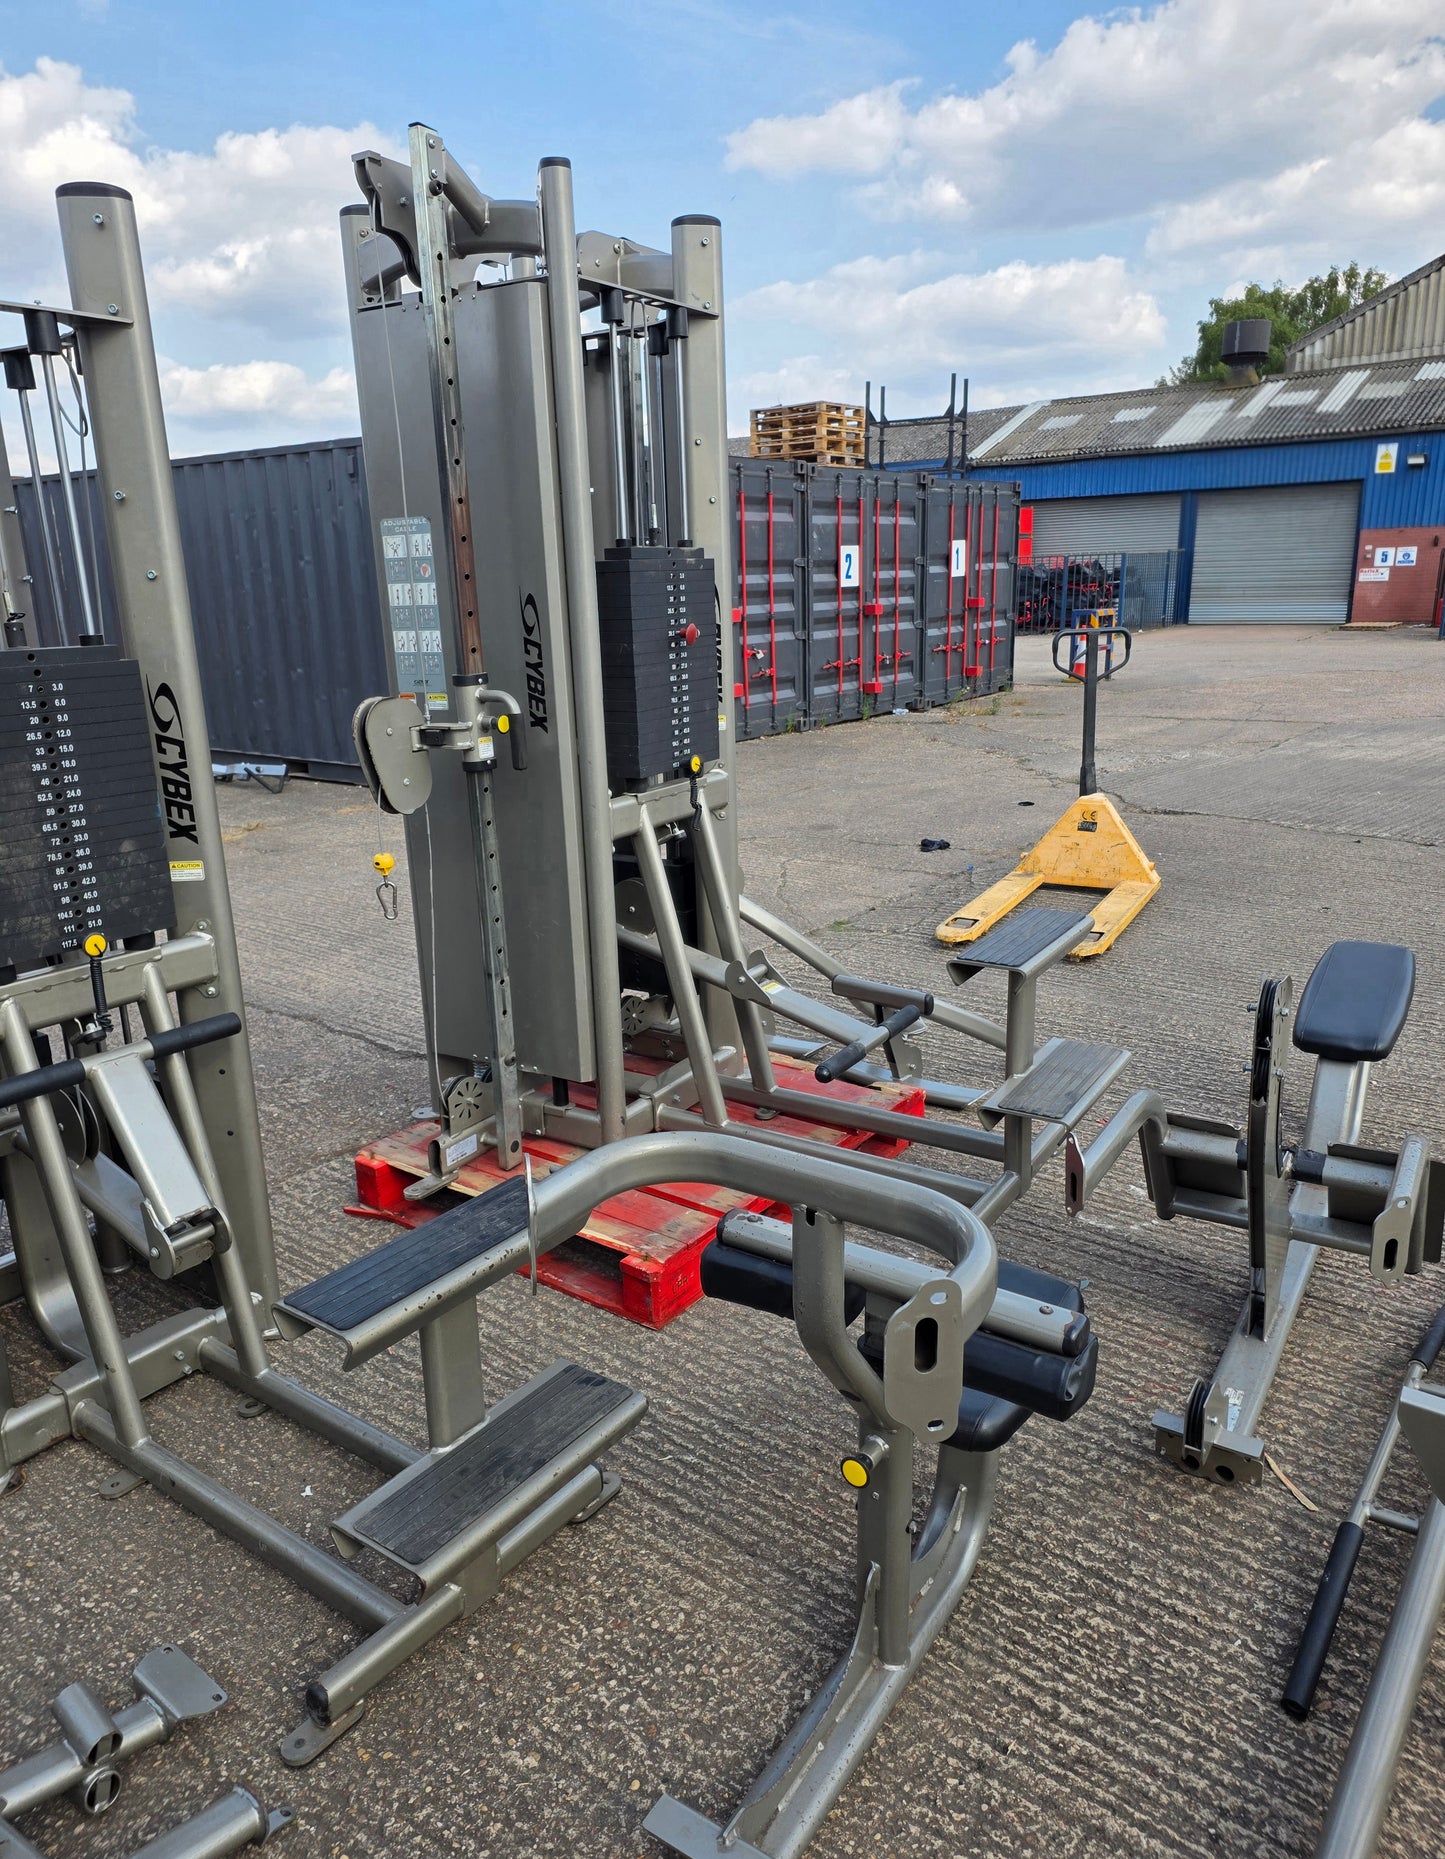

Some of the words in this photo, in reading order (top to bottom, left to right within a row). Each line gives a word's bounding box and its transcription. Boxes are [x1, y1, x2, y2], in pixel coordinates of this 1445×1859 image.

[955, 548, 960, 570] 1
[1381, 551, 1389, 563] 5
[845, 553, 852, 580] 2
[52, 683, 63, 691] 3.0
[523, 636, 549, 734] CYBEX
[21, 701, 36, 709] 13.5
[57, 714, 68, 722] 9.0
[26, 732, 42, 740] 26.5
[56, 729, 71, 737] 12.0
[36, 747, 45, 755] 33
[59, 744, 73, 752] 15.0
[32, 763, 47, 771] 39.5
[64, 774, 78, 783] 21.0
[38, 793, 52, 801] 52.5
[66, 789, 81, 798] 24.0
[153, 735, 199, 845] CYBEX
[46, 808, 55, 816] 59
[69, 804, 83, 812] 27.0
[43, 823, 57, 832] 65.5
[72, 819, 86, 827] 30.0
[51, 838, 60, 846] 72
[74, 833, 88, 843] 33.0
[47, 853, 62, 861] 78.5
[75, 848, 90, 857] 36.0
[56, 867, 64, 875] 85
[78, 862, 92, 871] 39.0
[53, 882, 68, 890] 91.5
[82, 876, 96, 884] 42.0
[61, 896, 70, 904] 98
[84, 891, 97, 899] 45.0
[58, 911, 73, 919] 104.5
[87, 905, 100, 913] 48.0
[64, 925, 74, 933] 111
[88, 919, 102, 928] 51.0
[62, 939, 77, 948] 117.5
